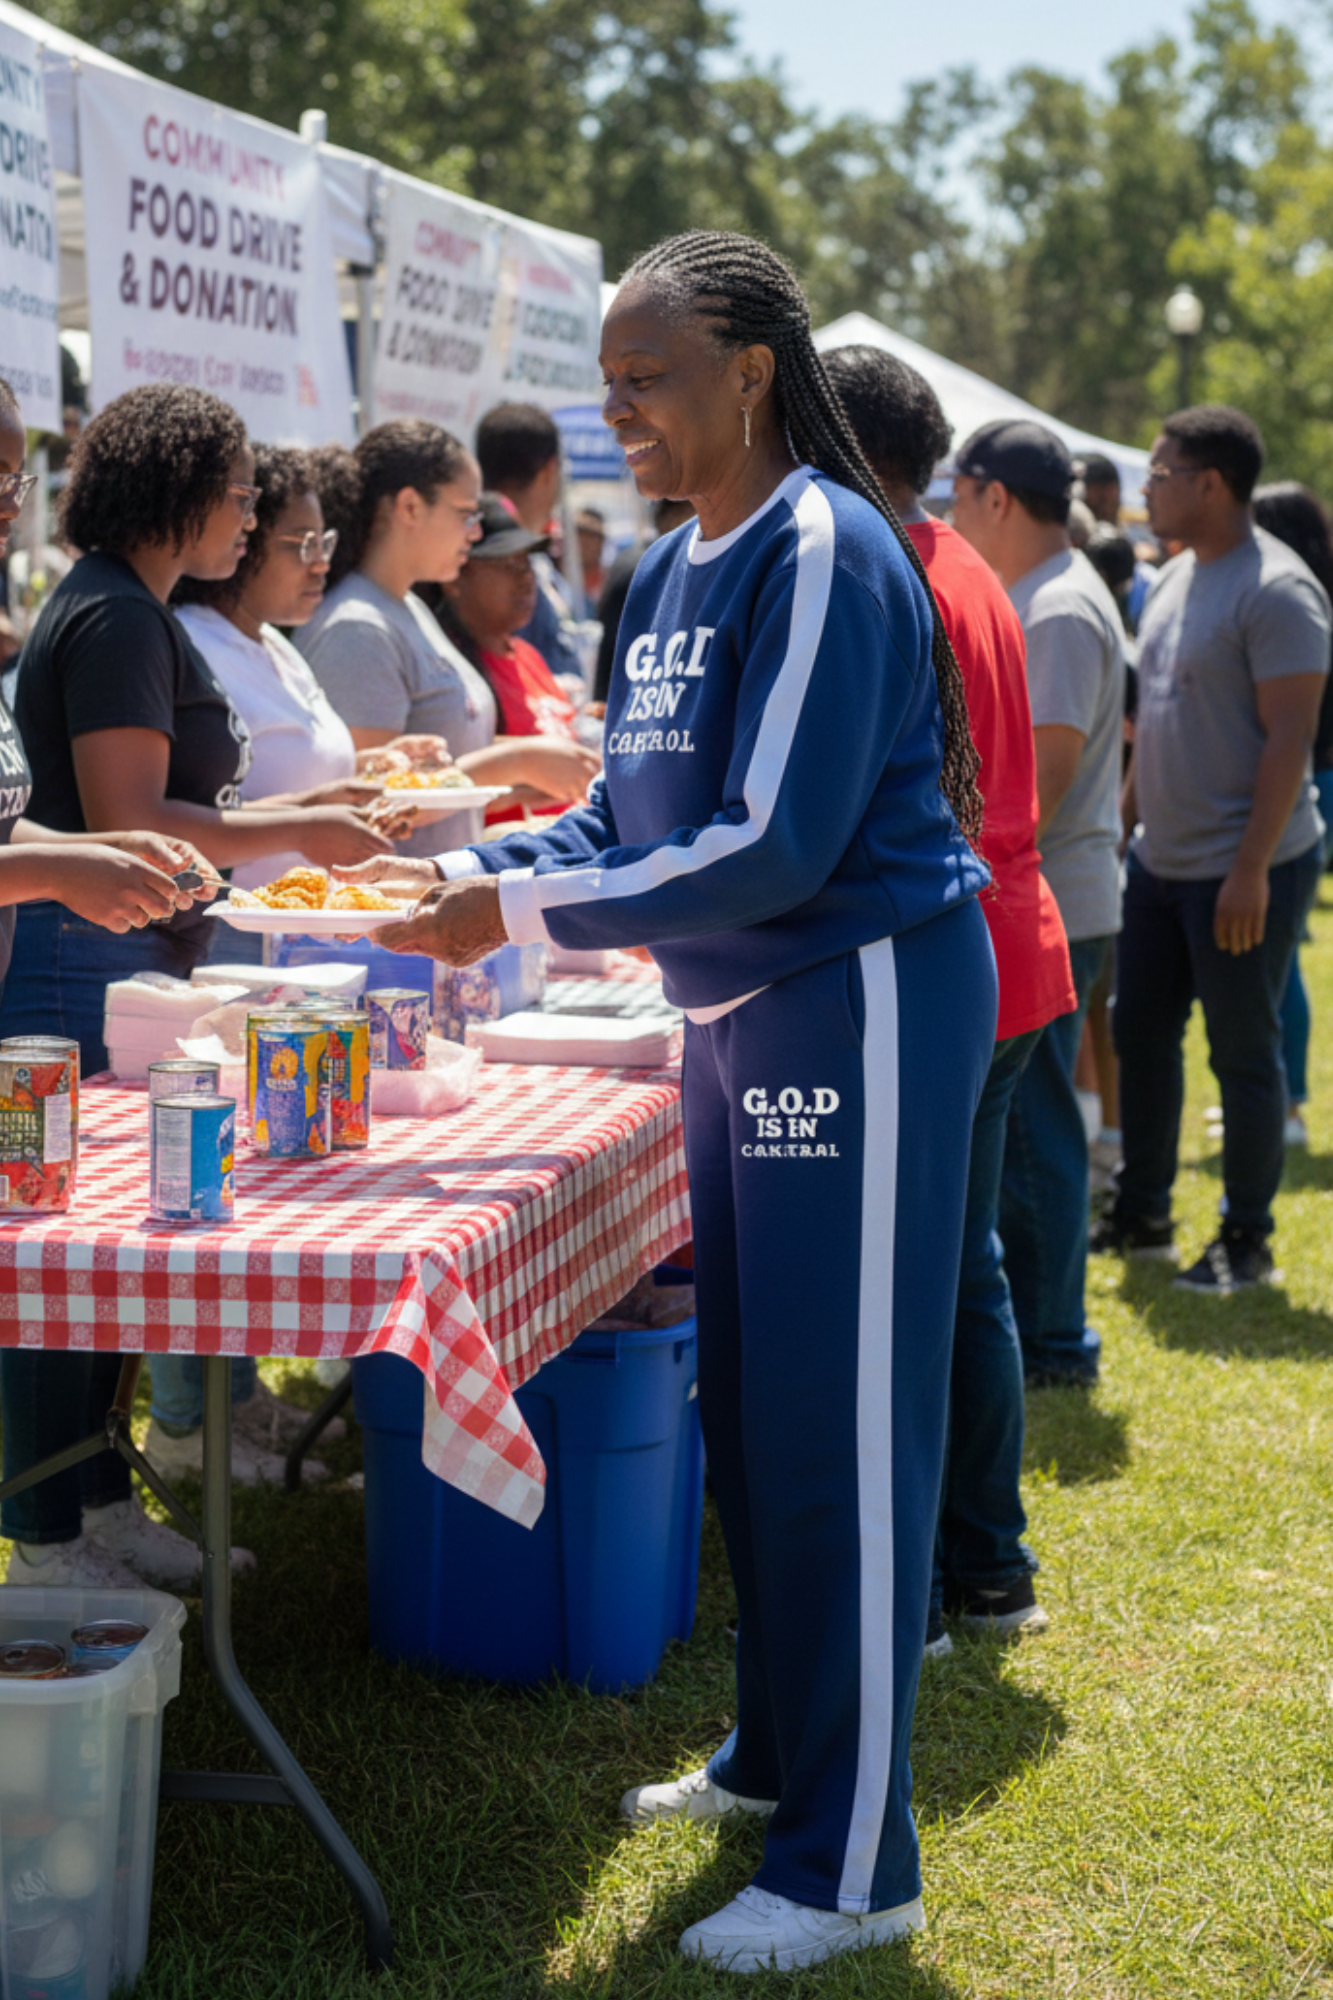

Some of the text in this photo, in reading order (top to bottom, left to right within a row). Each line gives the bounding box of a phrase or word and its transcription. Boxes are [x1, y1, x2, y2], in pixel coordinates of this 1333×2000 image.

[143, 114, 285, 202] COMMUNITY
[128, 176, 303, 274] FOOD DRIVE
[119, 250, 141, 307] &
[149, 257, 298, 338] DONATION
[743, 1086, 840, 1115] G.O.D
[757, 1117, 783, 1137] IS
